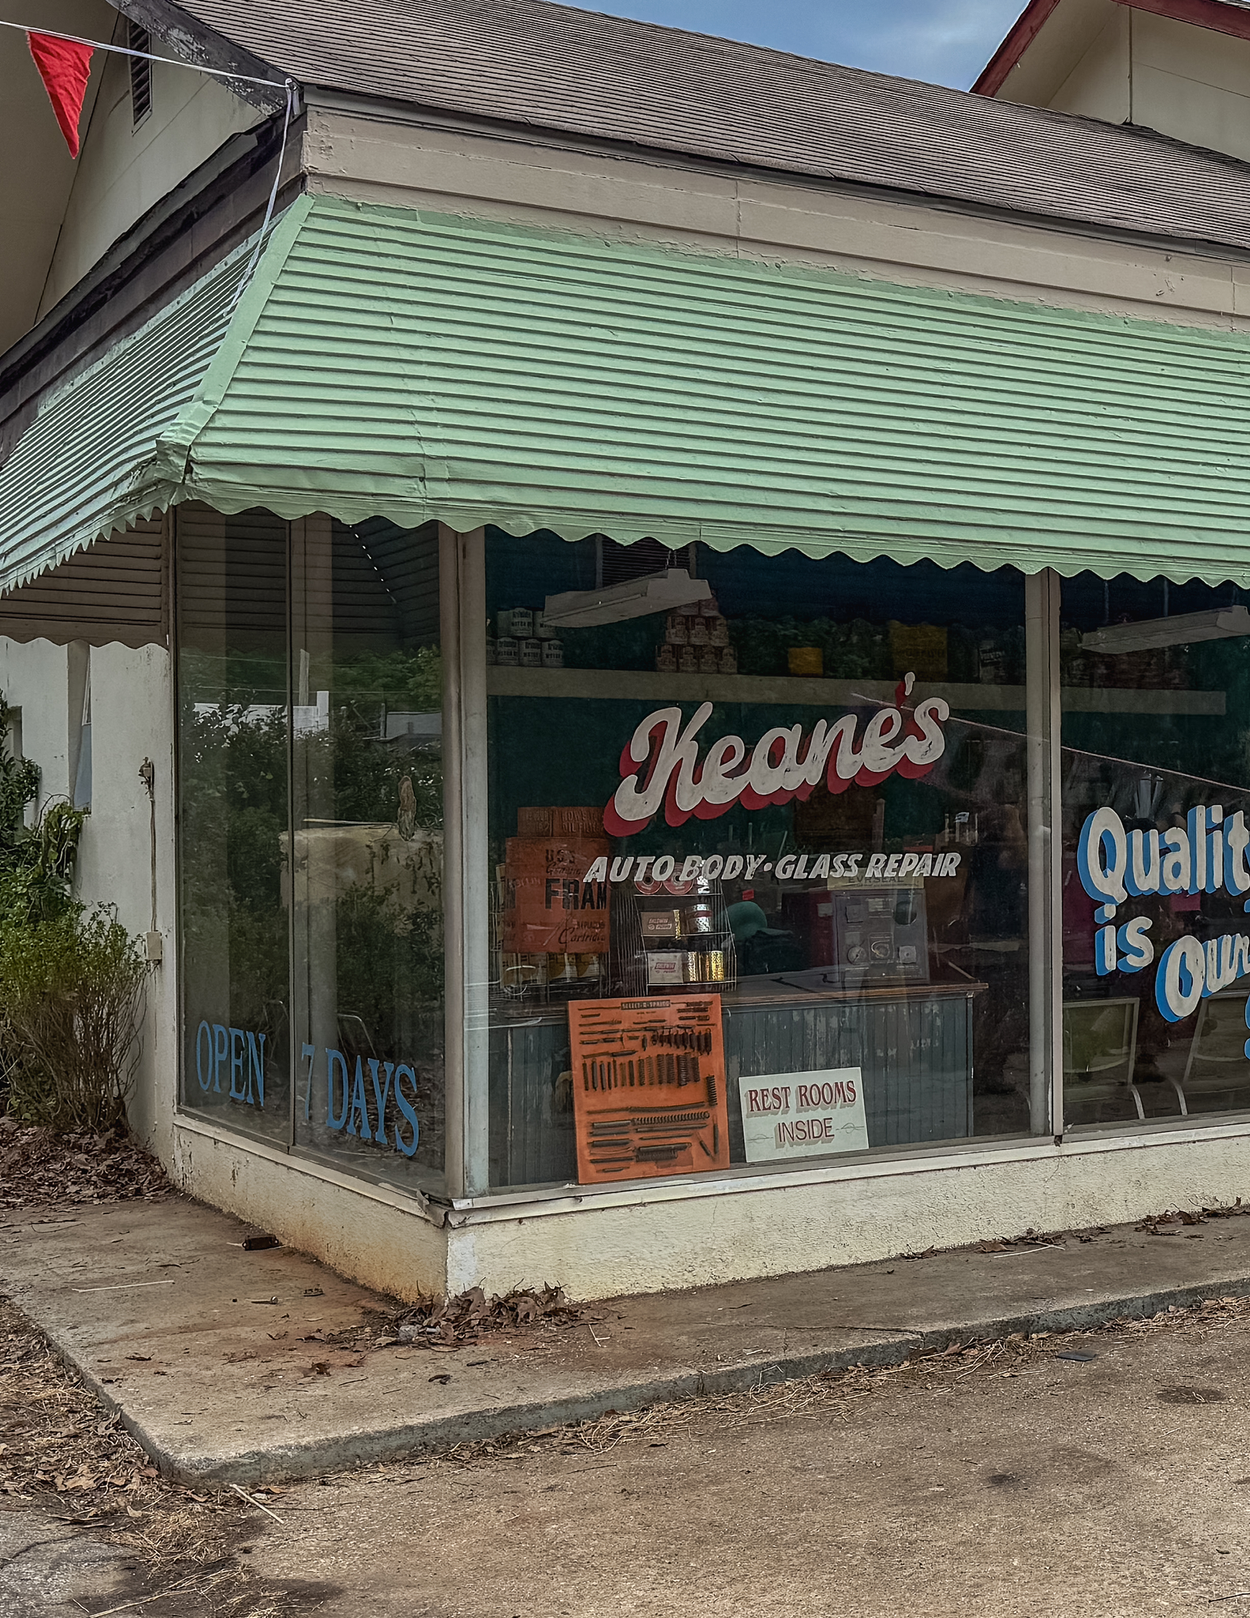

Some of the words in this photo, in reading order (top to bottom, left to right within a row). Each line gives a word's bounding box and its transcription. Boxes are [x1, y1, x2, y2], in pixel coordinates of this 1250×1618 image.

[604, 672, 950, 836] Keane's
[583, 857, 677, 882] AUTO
[678, 855, 766, 882] BODY
[775, 853, 865, 879] GLASS
[864, 852, 962, 878] REPAIR
[1095, 903, 1155, 975] is
[196, 1020, 266, 1107] OPEN
[301, 1042, 315, 1121] 7
[325, 1047, 419, 1157] DAYS
[747, 1086, 791, 1112] REST
[797, 1080, 857, 1108] ROOMS
[776, 1117, 835, 1143] INSIDE
